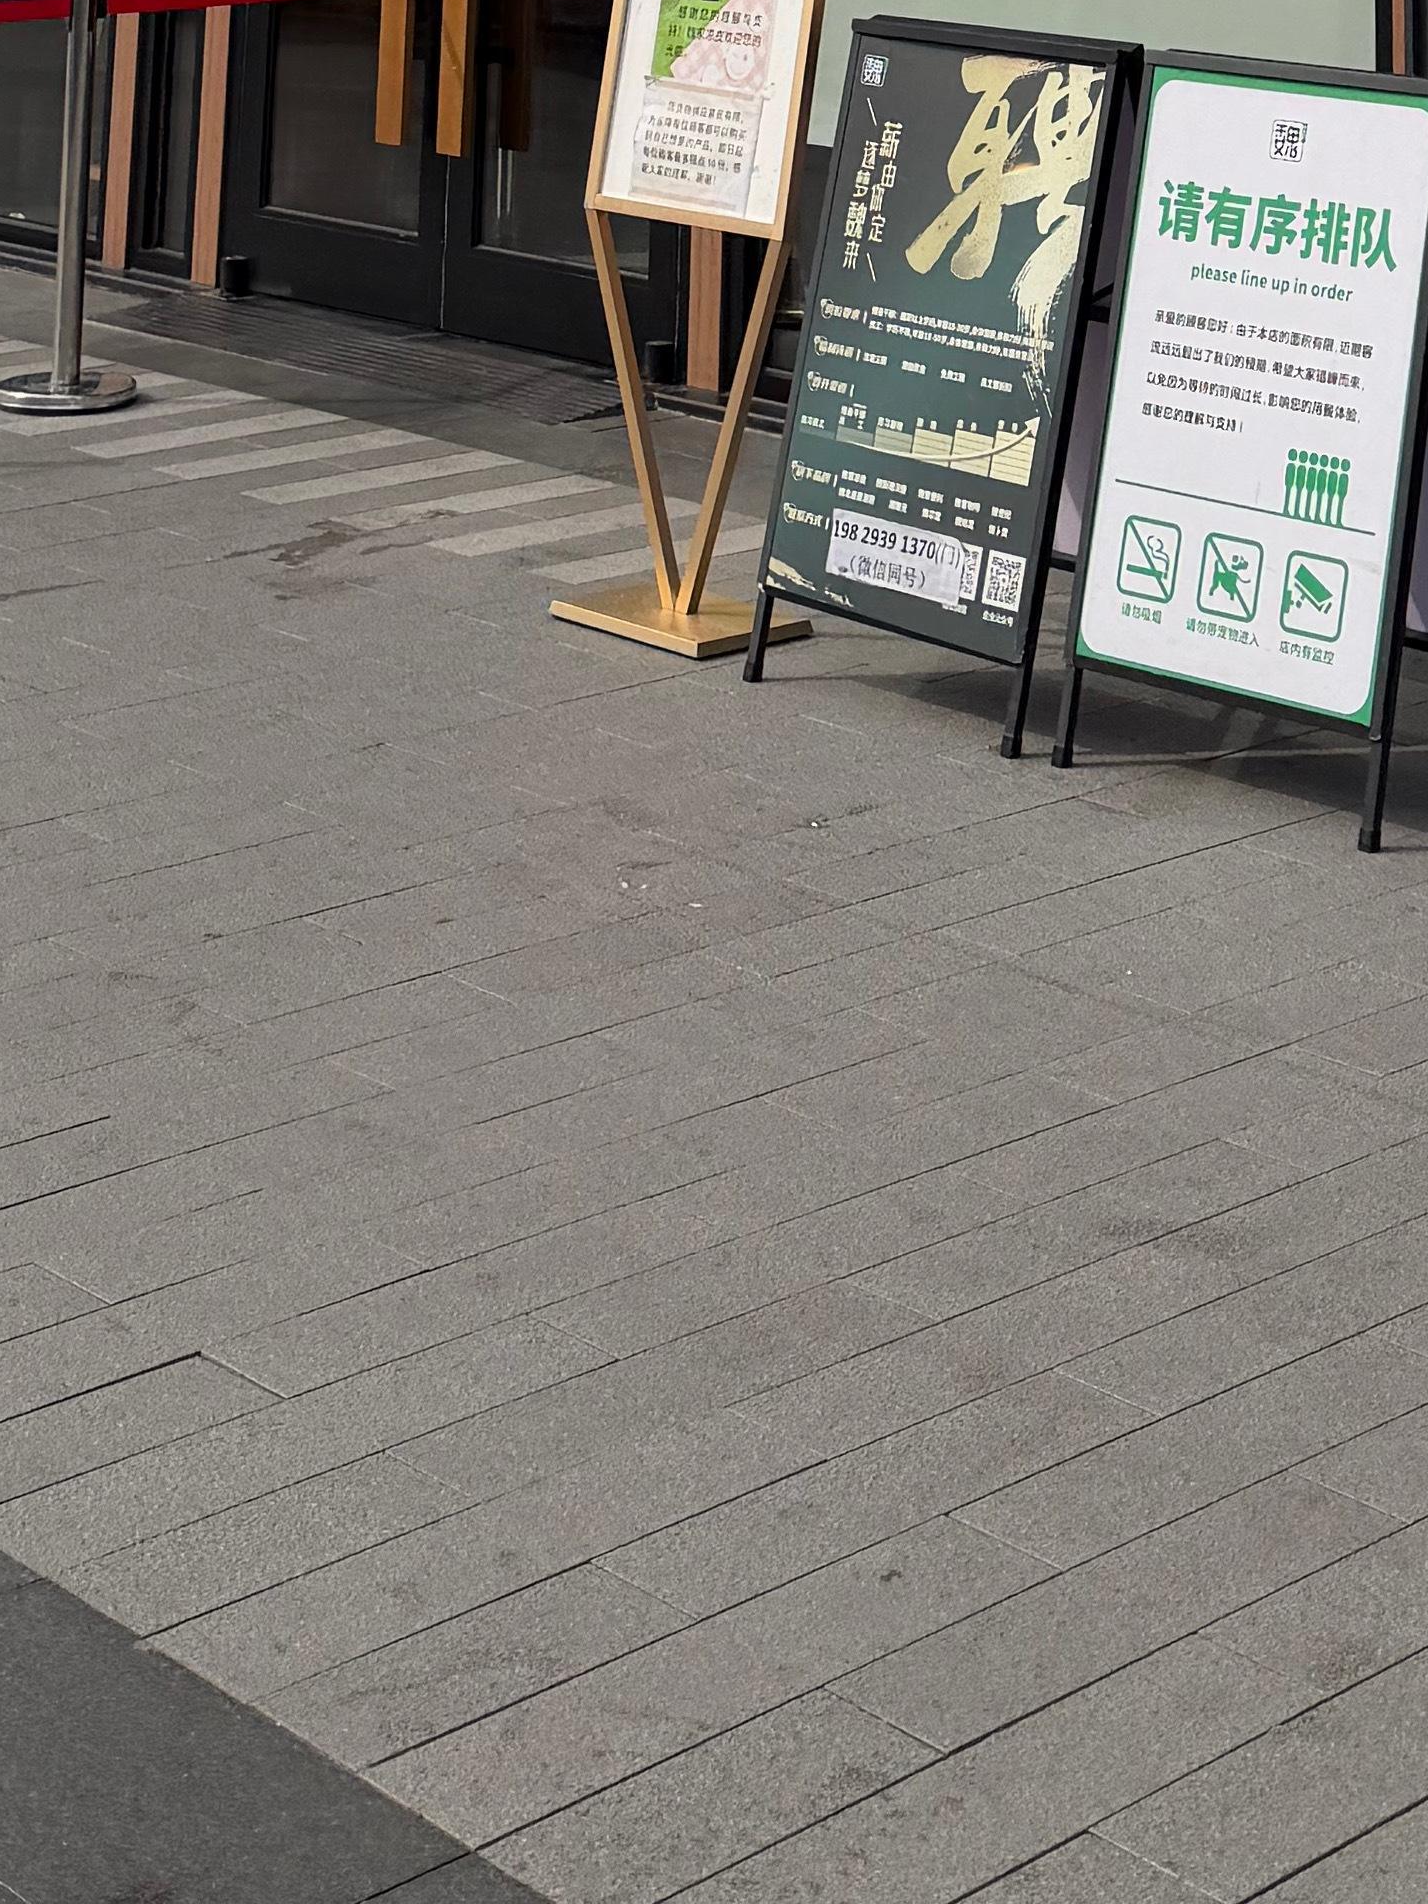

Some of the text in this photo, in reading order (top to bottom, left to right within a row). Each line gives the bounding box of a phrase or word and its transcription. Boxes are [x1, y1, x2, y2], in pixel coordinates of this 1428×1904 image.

[867, 120, 903, 243] 薪由你定
[905, 54, 1106, 322] 聘
[1274, 123, 1300, 159] 魏
[843, 139, 879, 270] 逐梦魏来
[1157, 179, 1397, 273] 请有序排队
[1190, 263, 1354, 302] please line up in order
[833, 520, 858, 541] 198
[860, 526, 897, 551] 2939
